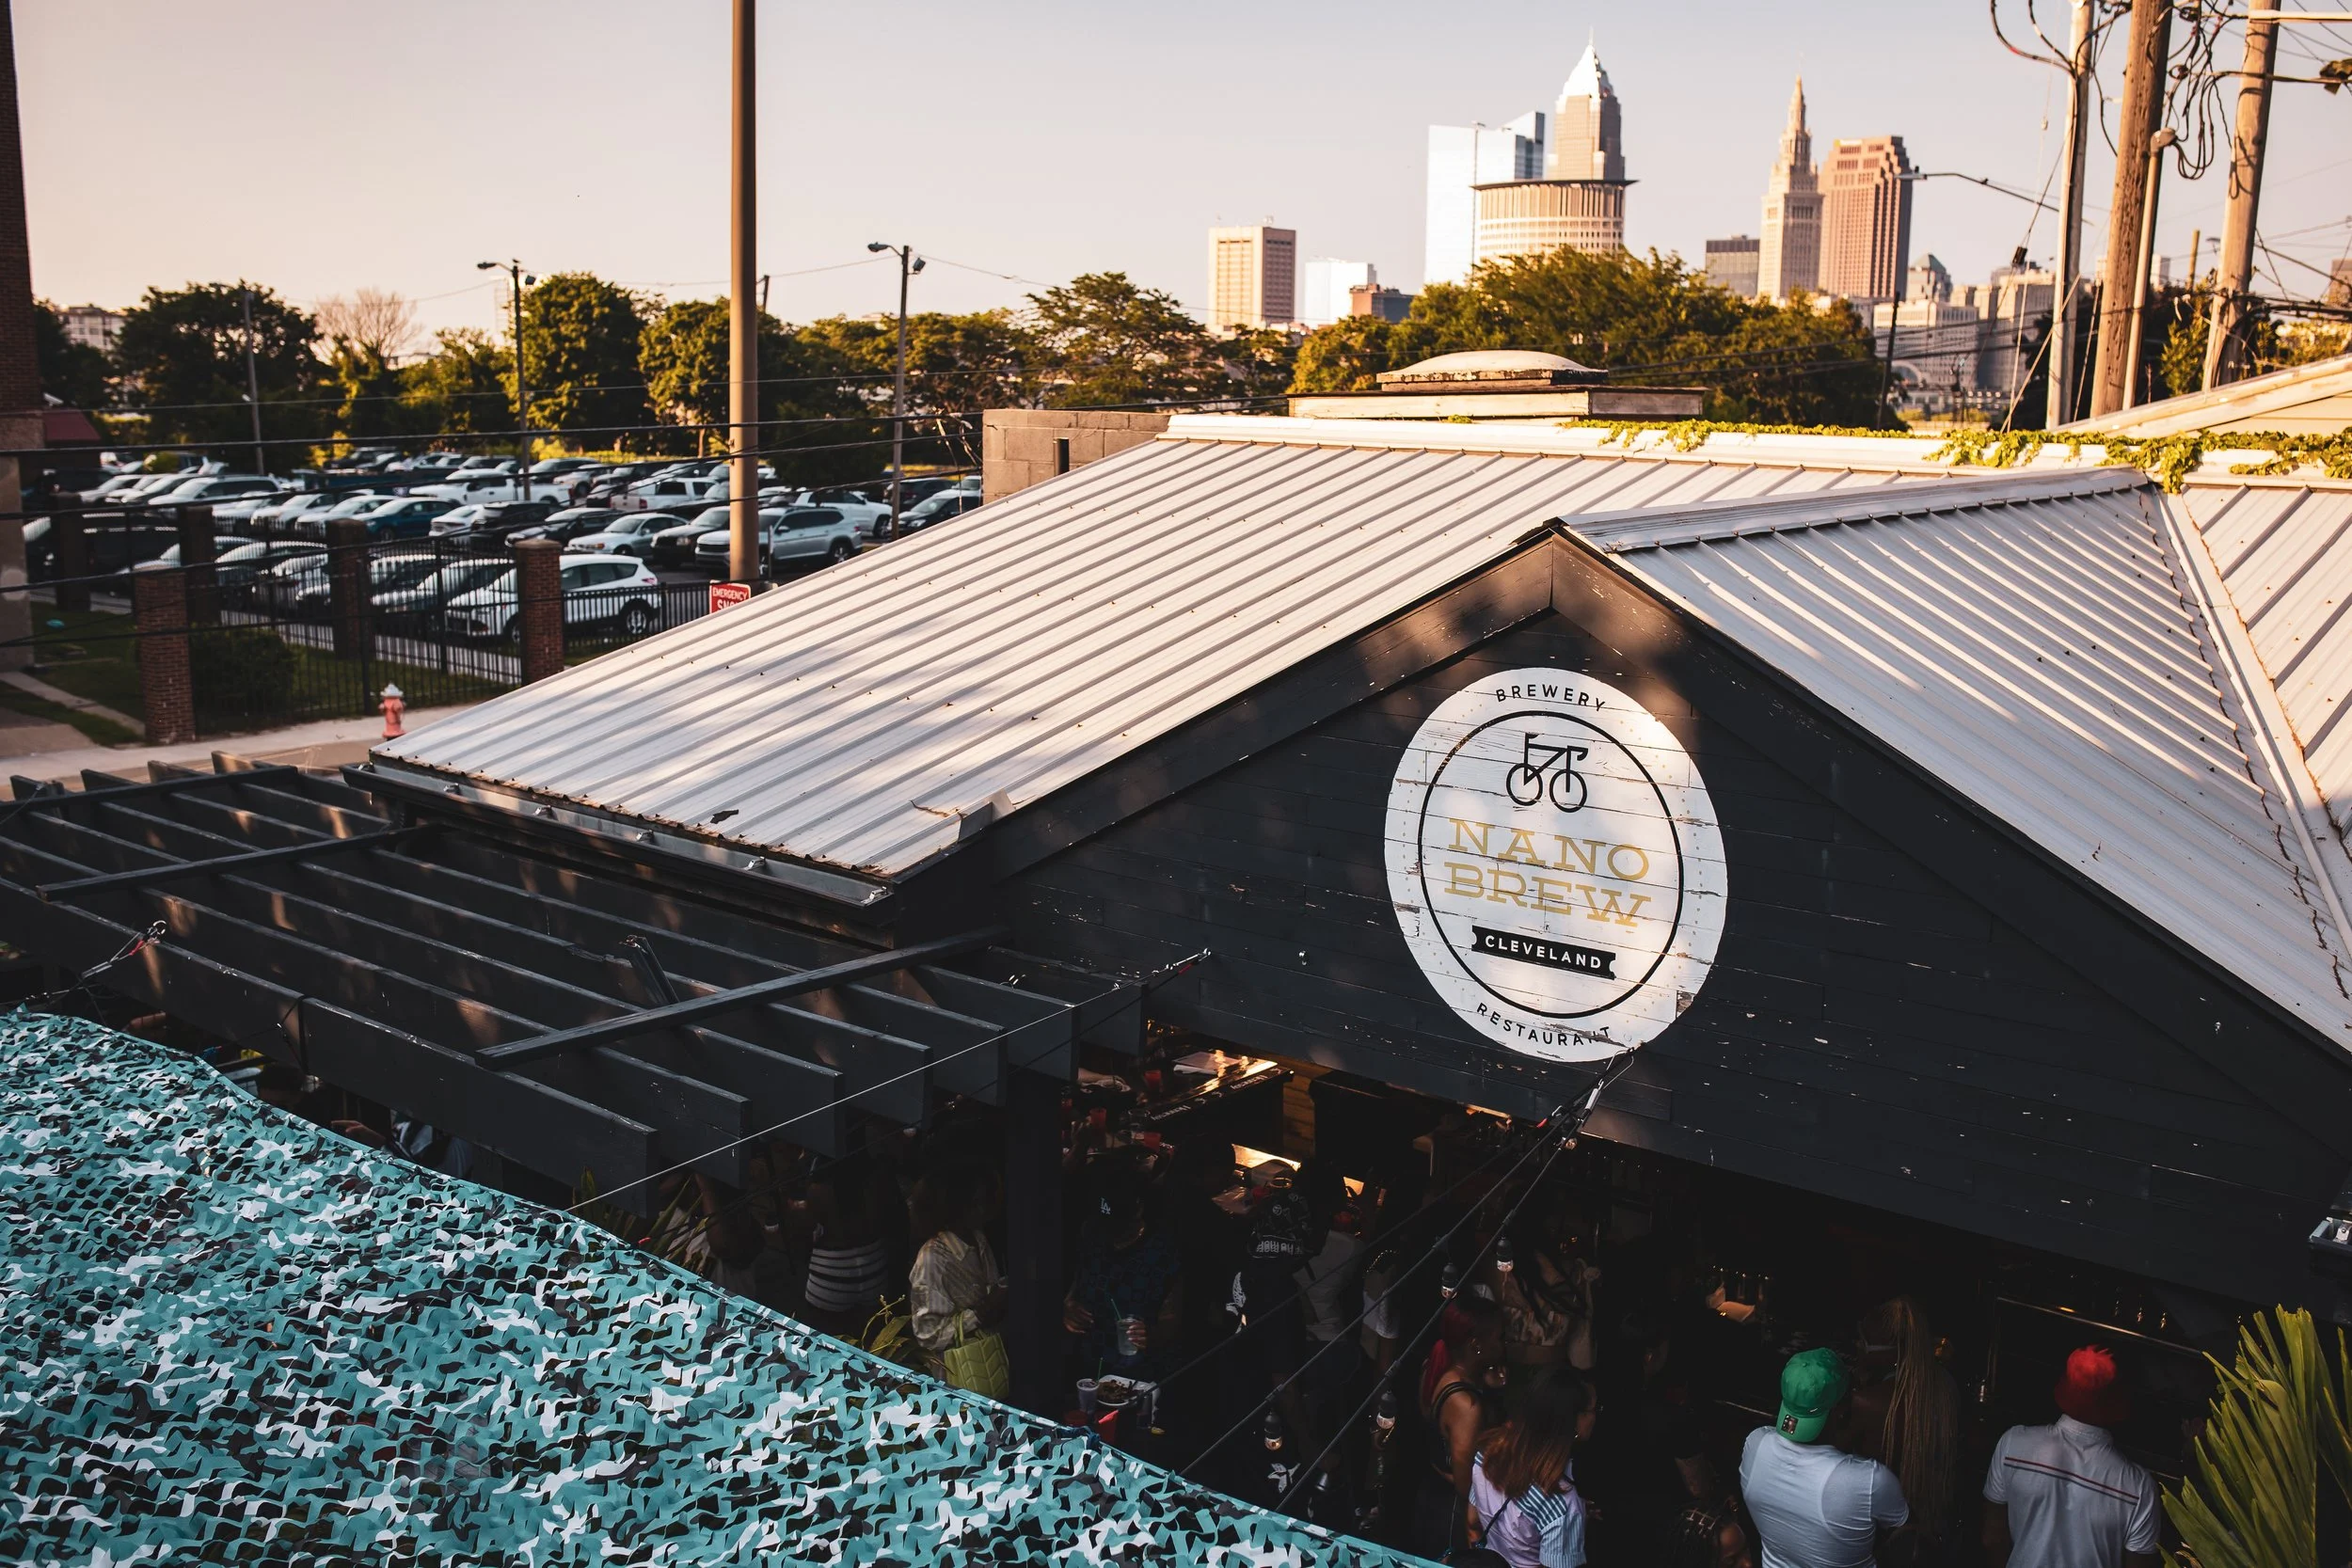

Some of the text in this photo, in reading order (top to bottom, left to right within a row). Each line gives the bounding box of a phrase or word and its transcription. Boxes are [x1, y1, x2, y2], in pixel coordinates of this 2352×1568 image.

[712, 587, 748, 601] EMERGENCY
[1496, 684, 1605, 712] BREWERY
[1449, 818, 1649, 880] NANO
[1444, 862, 1652, 927] BREW
[1485, 935, 1601, 969] CLEVELAND
[1100, 1197, 1111, 1215] LA
